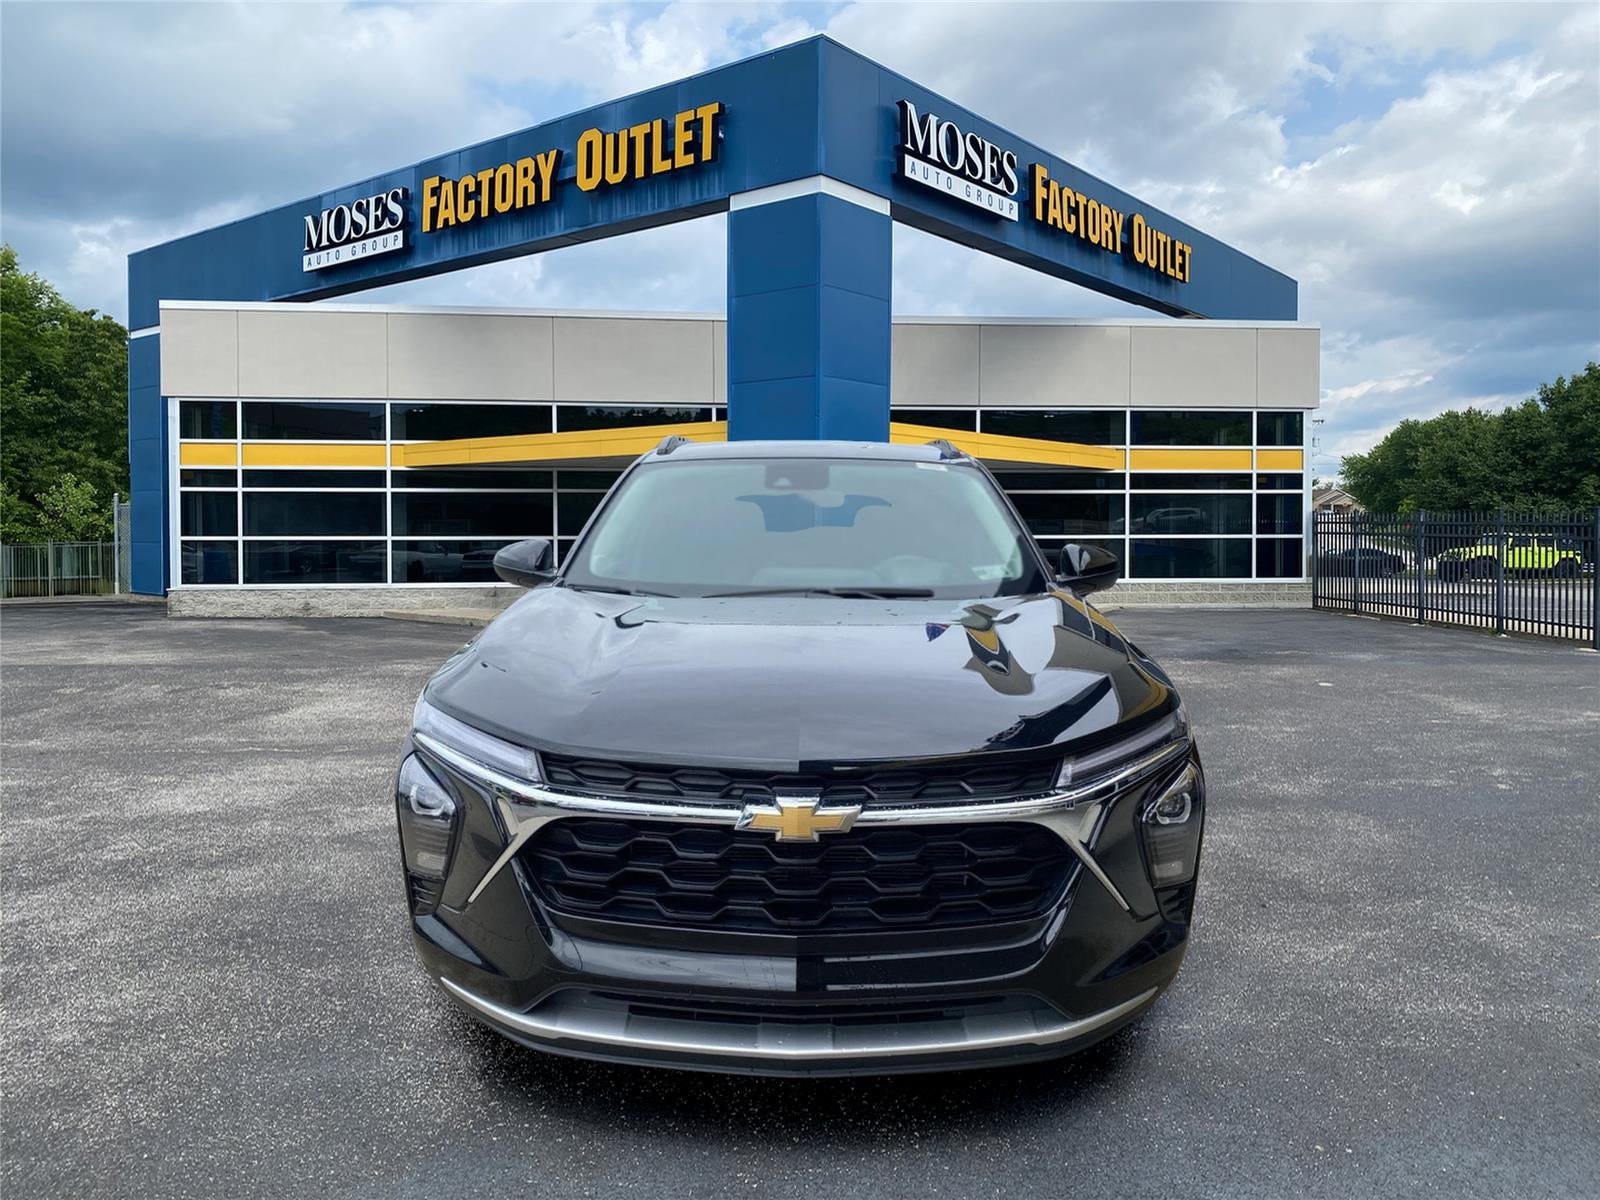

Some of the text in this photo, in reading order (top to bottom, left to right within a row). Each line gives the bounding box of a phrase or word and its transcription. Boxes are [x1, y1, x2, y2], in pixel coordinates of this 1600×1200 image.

[422, 102, 720, 232] FACTORY OUTLET
[904, 100, 1018, 196] MOSES
[910, 161, 1014, 214] AUTO GROUP
[303, 187, 403, 251] MOSES
[307, 234, 399, 268] AUTO GROUP
[1035, 163, 1192, 283] FACTORY OUTLET
